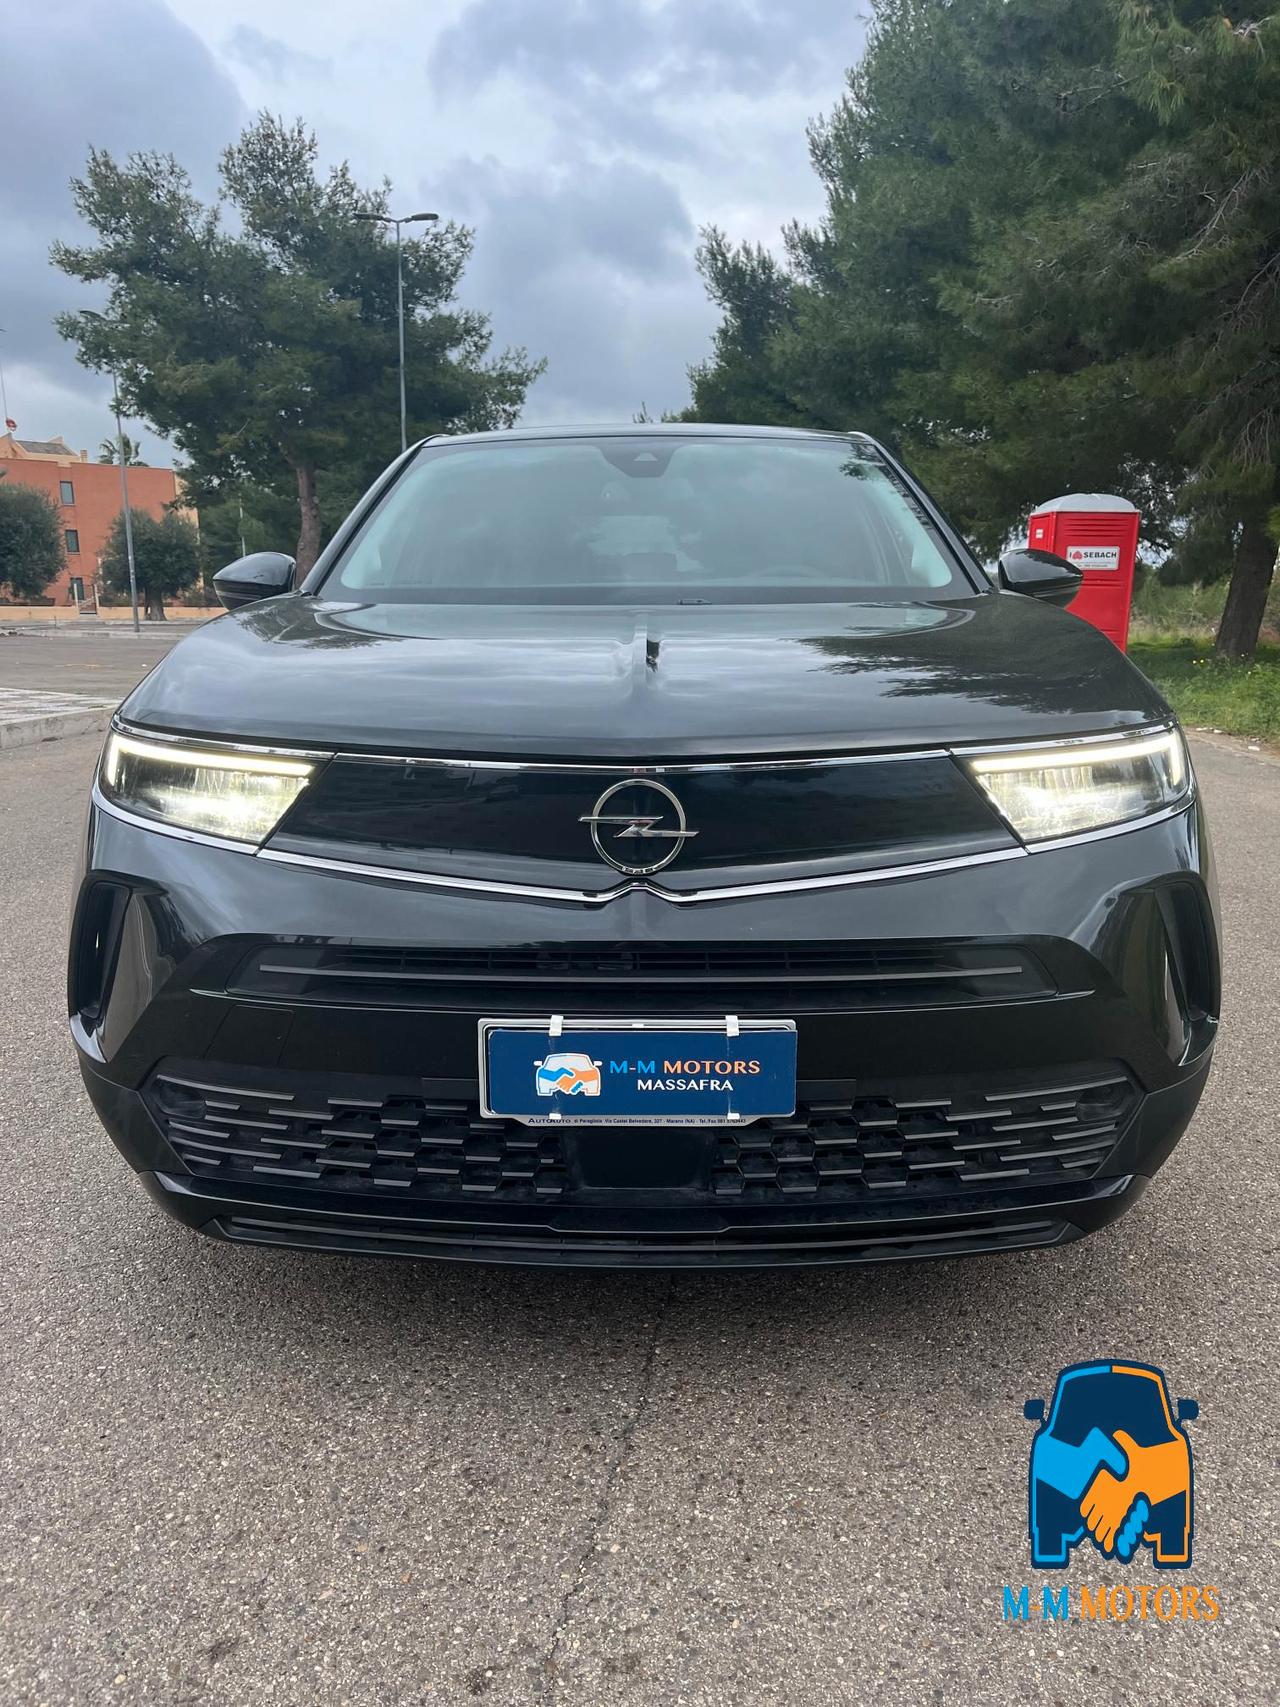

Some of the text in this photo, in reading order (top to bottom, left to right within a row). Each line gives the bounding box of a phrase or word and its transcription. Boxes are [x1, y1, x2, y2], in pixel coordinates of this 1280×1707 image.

[1083, 551, 1117, 559] SEBACH
[609, 1060, 761, 1075] M-M MOTORS
[636, 1079, 734, 1091] MASSAFRA
